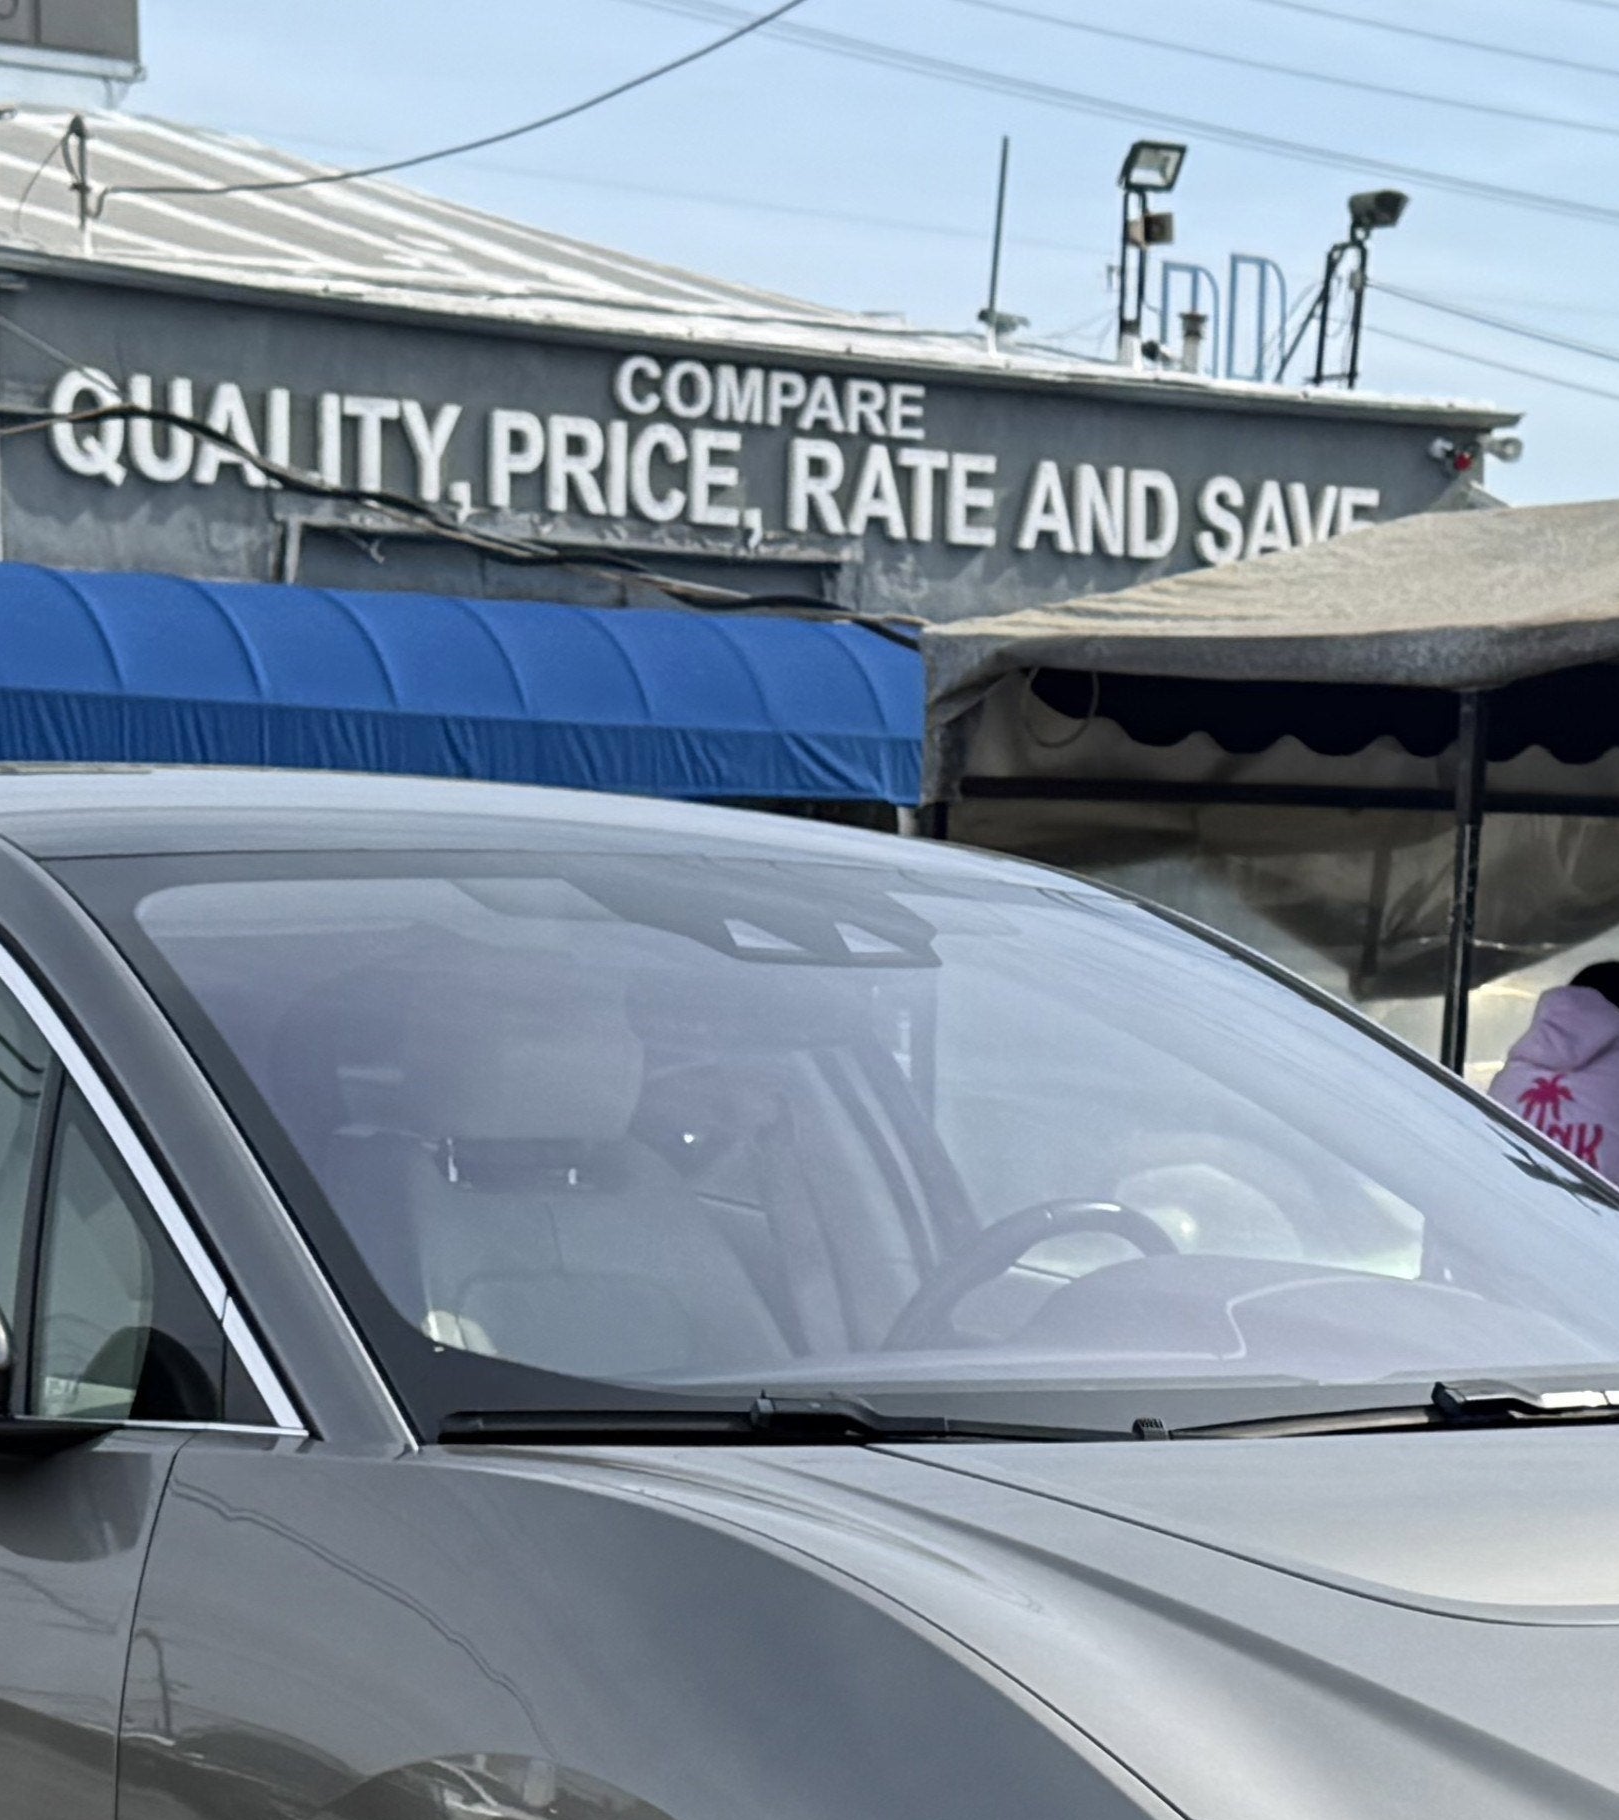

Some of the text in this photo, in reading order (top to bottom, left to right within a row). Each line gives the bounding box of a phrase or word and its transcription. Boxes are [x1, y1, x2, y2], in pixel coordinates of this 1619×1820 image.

[51, 366, 472, 524] QUALITY,
[490, 408, 764, 549] PRICE,
[787, 436, 997, 546] RATE
[1017, 460, 1179, 560] AND
[615, 355, 926, 440] COMPARE
